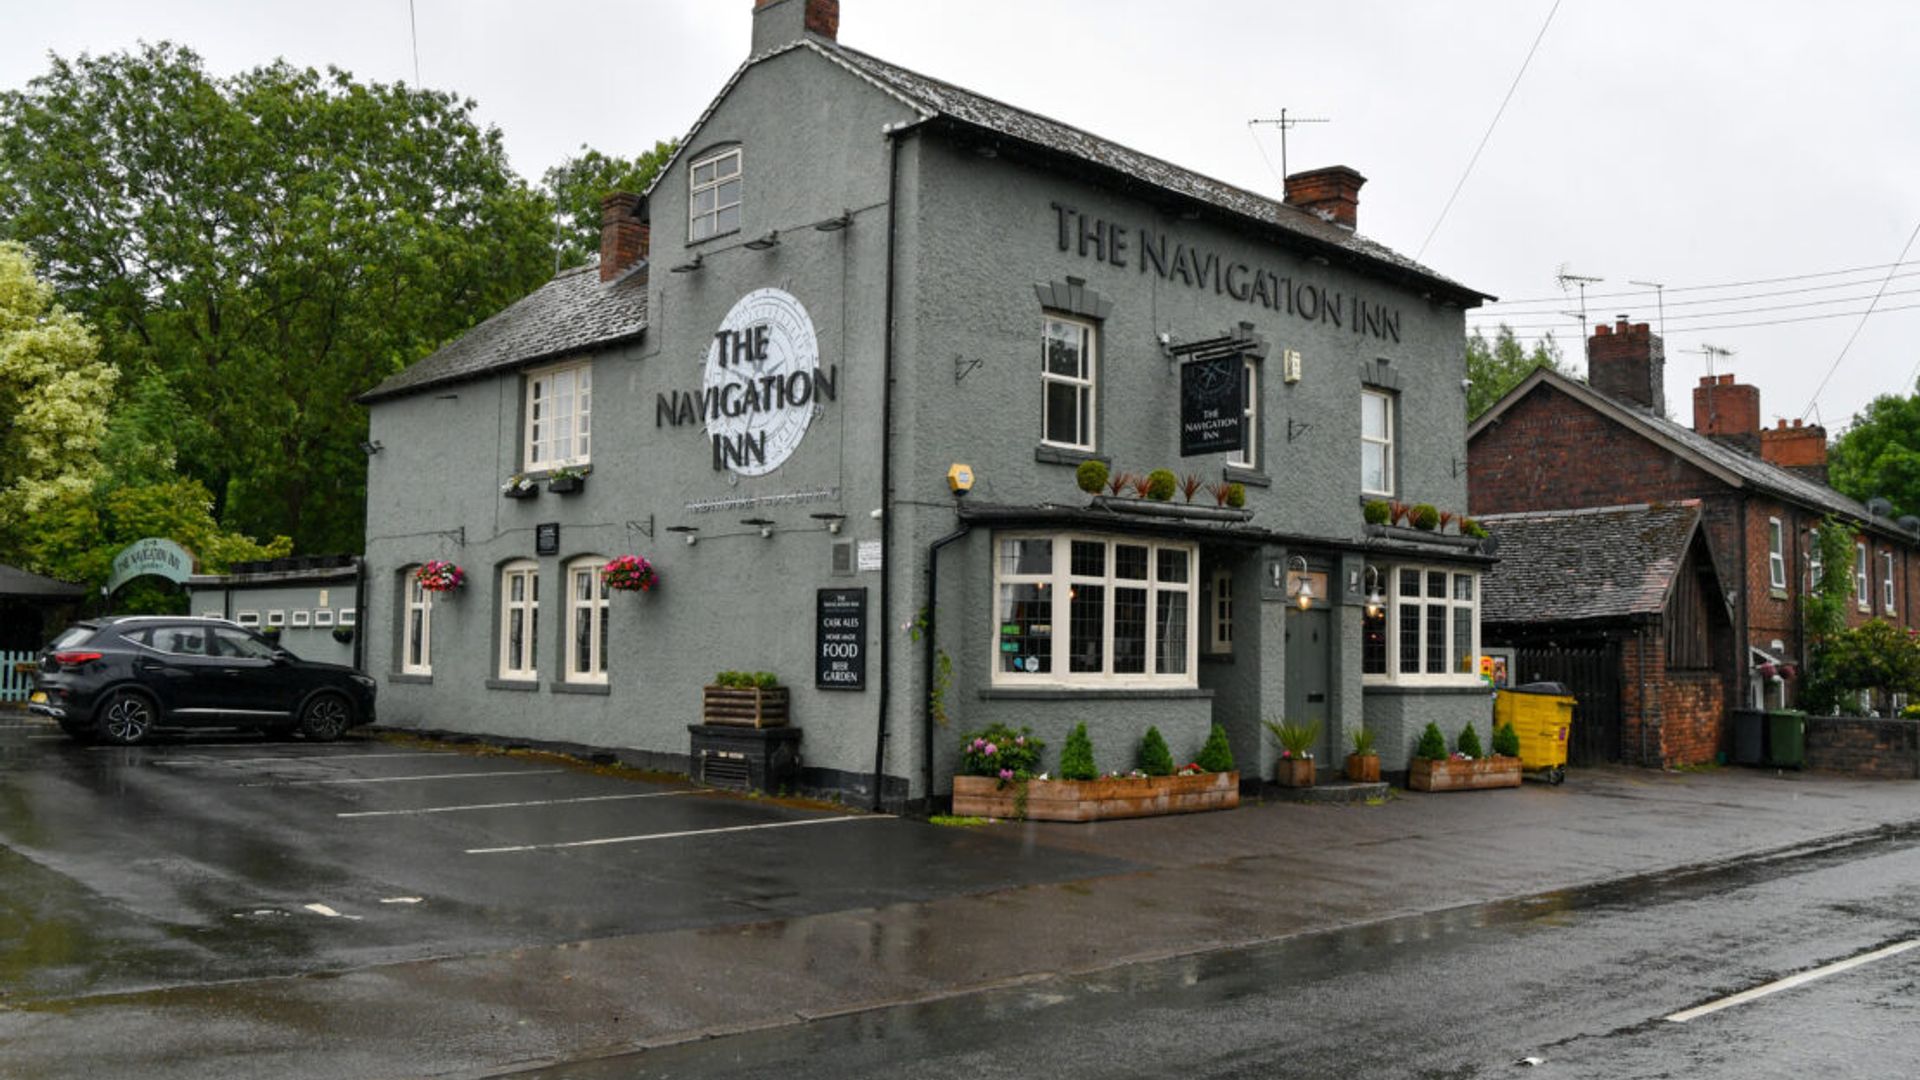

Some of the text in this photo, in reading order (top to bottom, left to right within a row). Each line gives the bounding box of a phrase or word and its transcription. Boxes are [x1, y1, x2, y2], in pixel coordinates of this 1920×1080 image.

[1051, 200, 1401, 344] THE NAVIGATION INN
[715, 324, 770, 368] THE
[656, 365, 837, 429] NAVIGATION
[1204, 409, 1219, 419] THE
[1185, 417, 1239, 433] NAVIGATION
[1203, 430, 1219, 440] INN
[712, 430, 766, 472] INN
[823, 618, 859, 628] CASK ALES
[823, 643, 858, 658] FOOD
[832, 661, 849, 671] BEER
[823, 671, 857, 682] GARDEN
